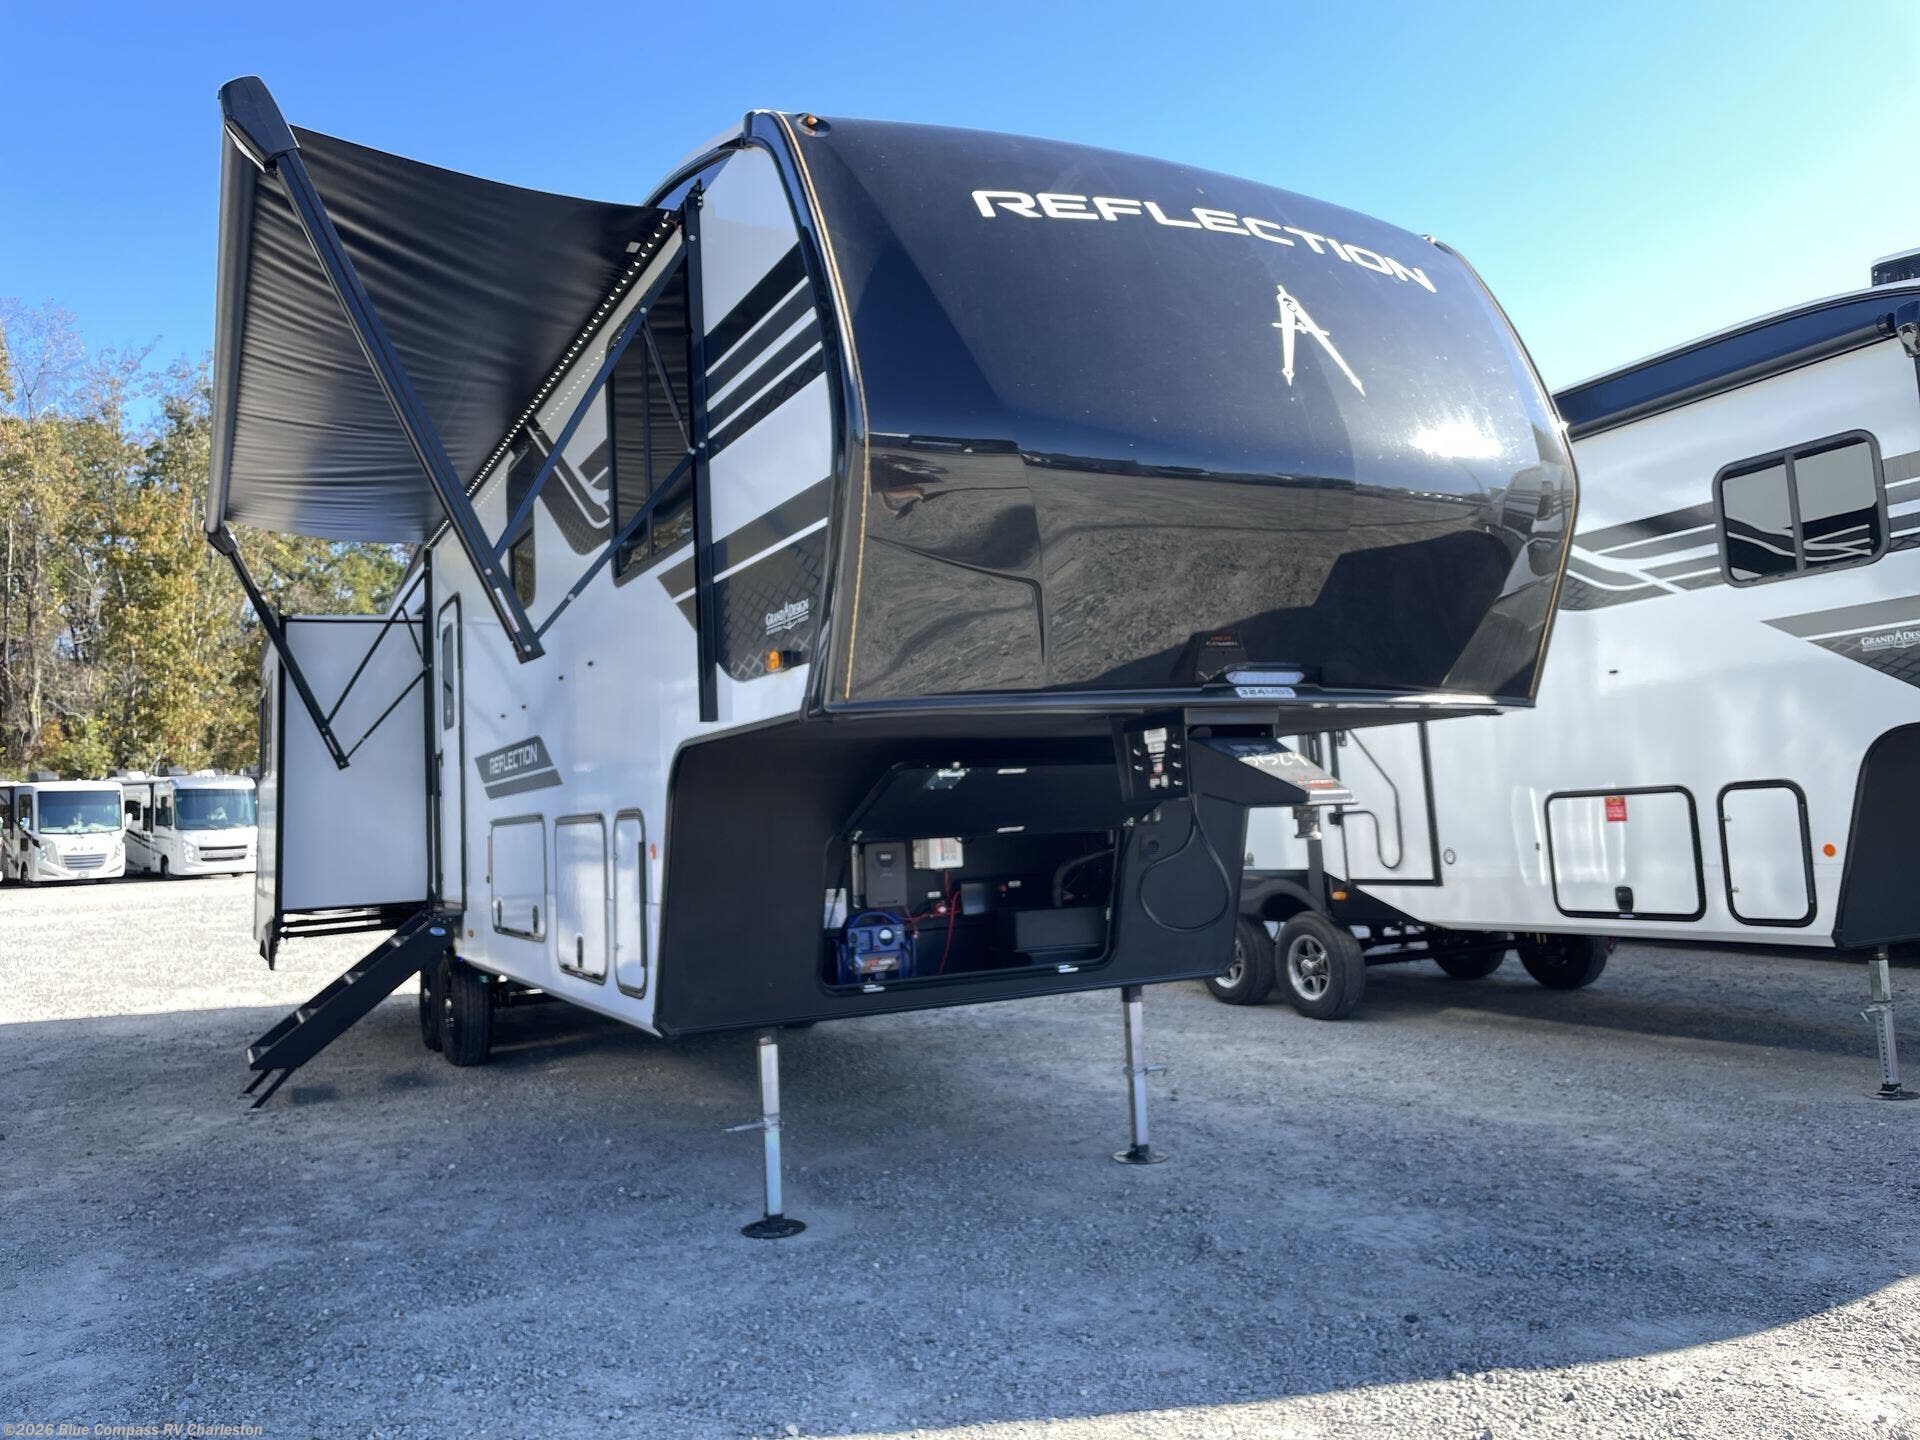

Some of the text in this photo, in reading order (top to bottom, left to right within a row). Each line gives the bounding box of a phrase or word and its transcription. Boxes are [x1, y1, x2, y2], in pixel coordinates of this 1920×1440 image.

[971, 190, 1437, 293] REFLECTION
[1861, 635, 1894, 645] GRAND
[490, 742, 538, 774] REFLECTION
